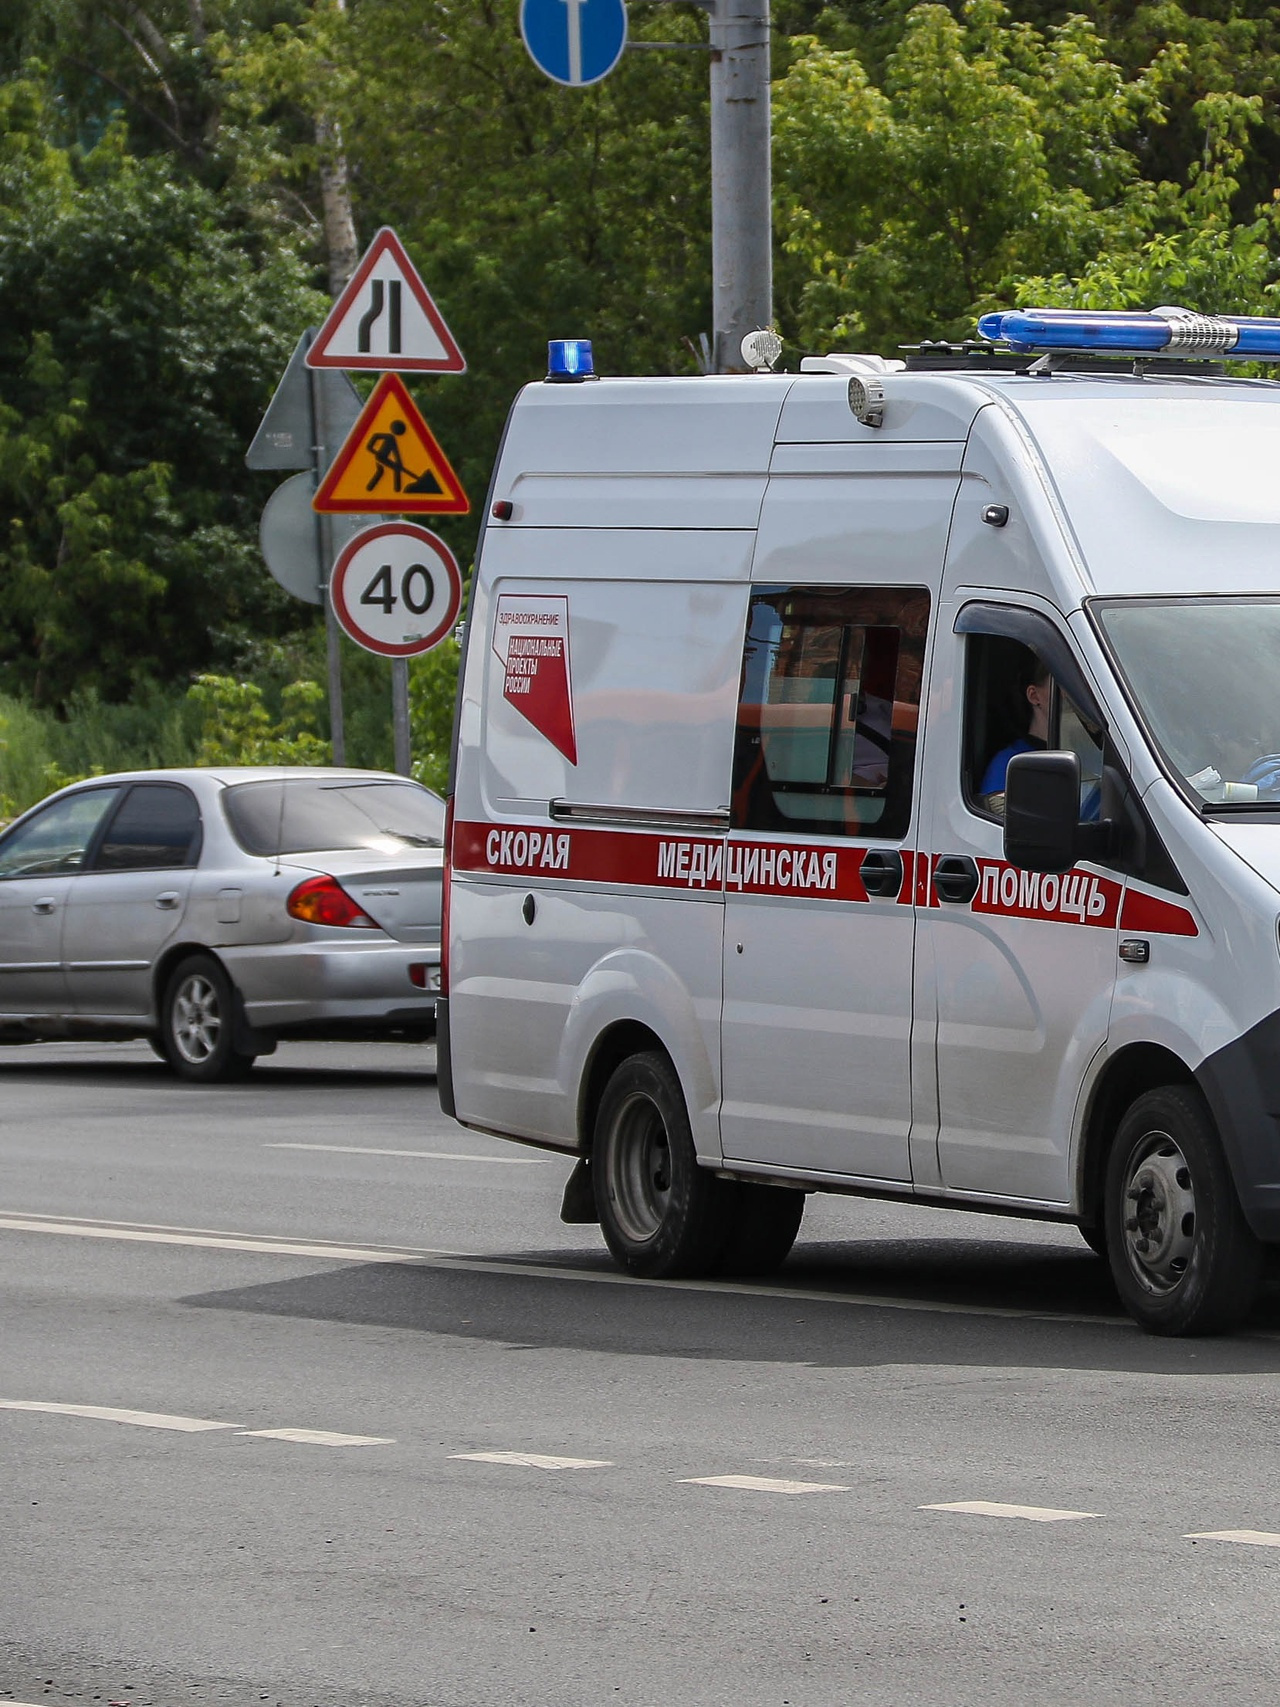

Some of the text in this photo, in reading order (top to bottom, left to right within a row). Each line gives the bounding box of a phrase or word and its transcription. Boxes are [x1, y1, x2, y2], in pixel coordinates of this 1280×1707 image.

[360, 564, 434, 614] 40
[499, 612, 559, 626] ЗДРАВООХРАНЕНИЕ
[508, 638, 562, 657] НАЦИОНАЛЬНЫЕ
[506, 657, 538, 675] ПРОЕКТЫ
[504, 676, 531, 694] РОССИИ
[485, 829, 1106, 922] СКОРАЯ МЕДИЦИНСКАЯ ПОМОЩЬ
